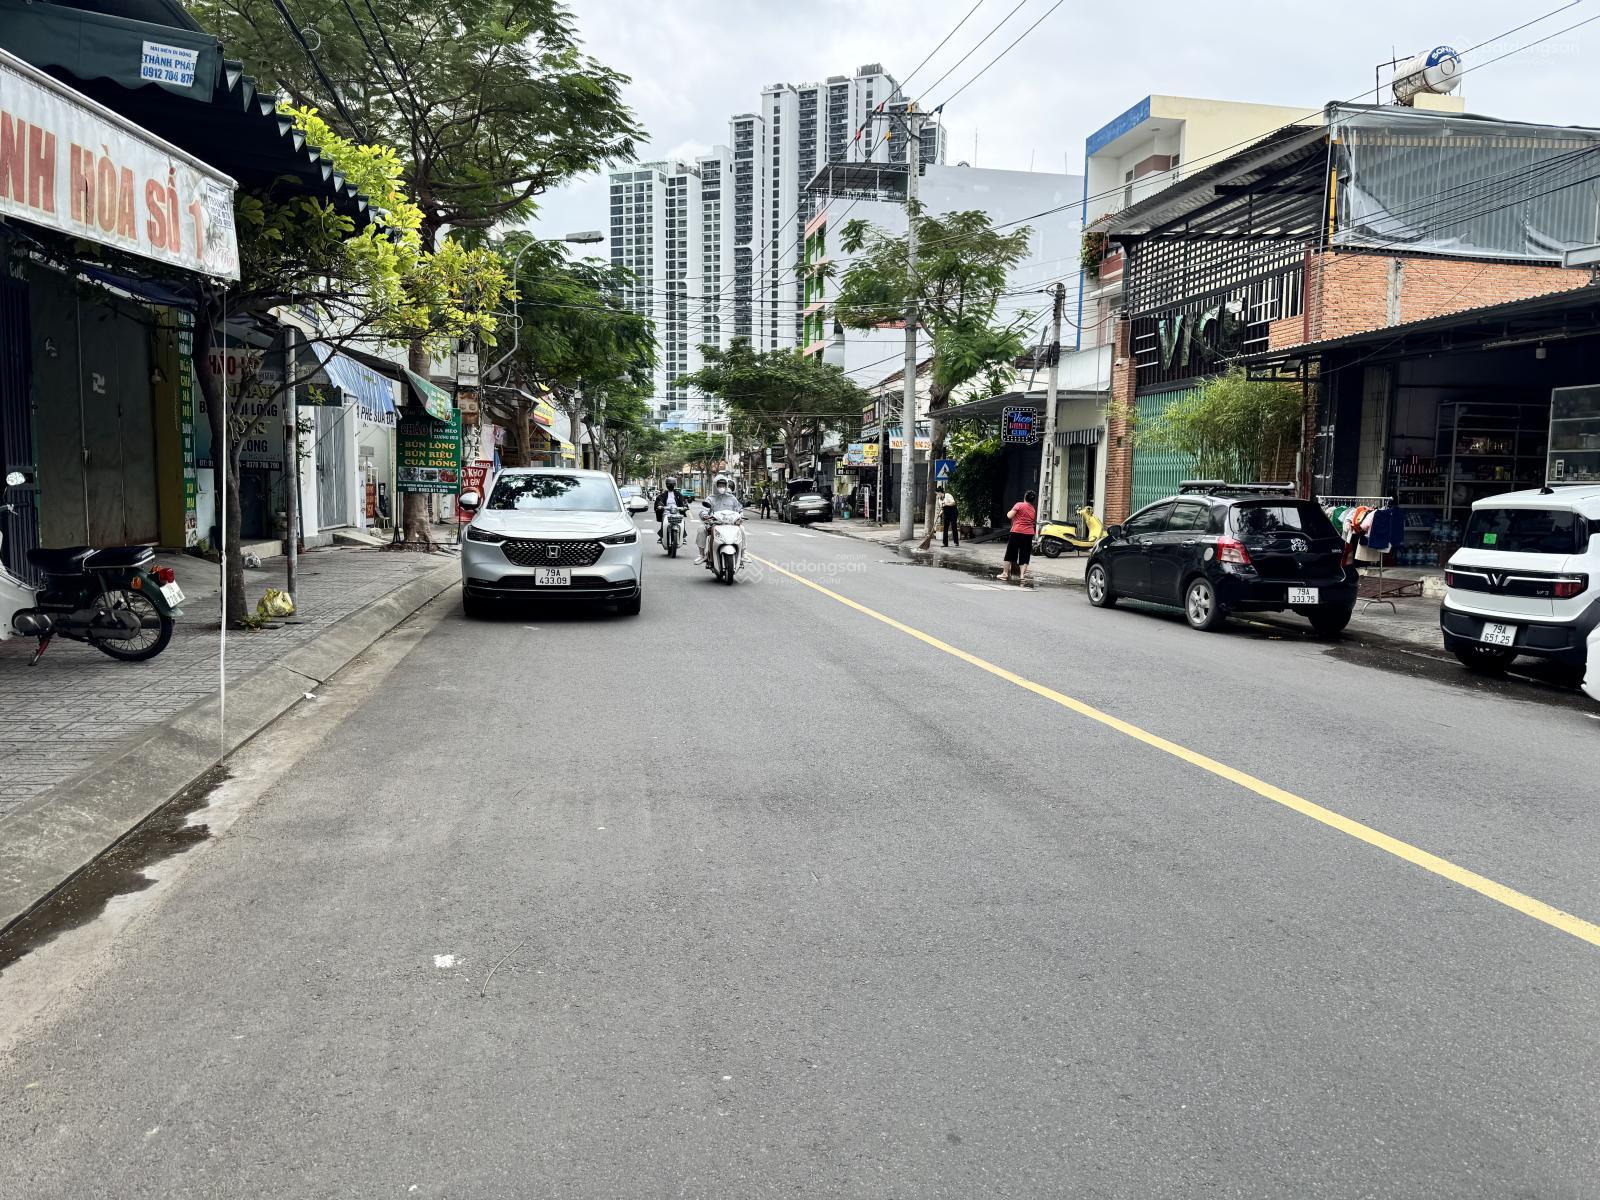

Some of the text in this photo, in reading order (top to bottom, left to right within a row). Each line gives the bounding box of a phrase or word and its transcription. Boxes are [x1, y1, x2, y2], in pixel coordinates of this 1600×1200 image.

[143, 65, 163, 79] 0912
[70, 143, 137, 240] HÒA
[1008, 411, 1033, 423] Vice
[404, 440, 456, 449] BÚN LÒNG
[404, 449, 427, 457] BÚN
[428, 458, 457, 467] ĐỒNG
[545, 568, 561, 577] 79A
[539, 576, 567, 585] 433.09
[1297, 588, 1310, 596] 79A
[1292, 595, 1316, 603] 333.75
[1493, 625, 1507, 635] 79A
[1484, 633, 1511, 645] 651.25
